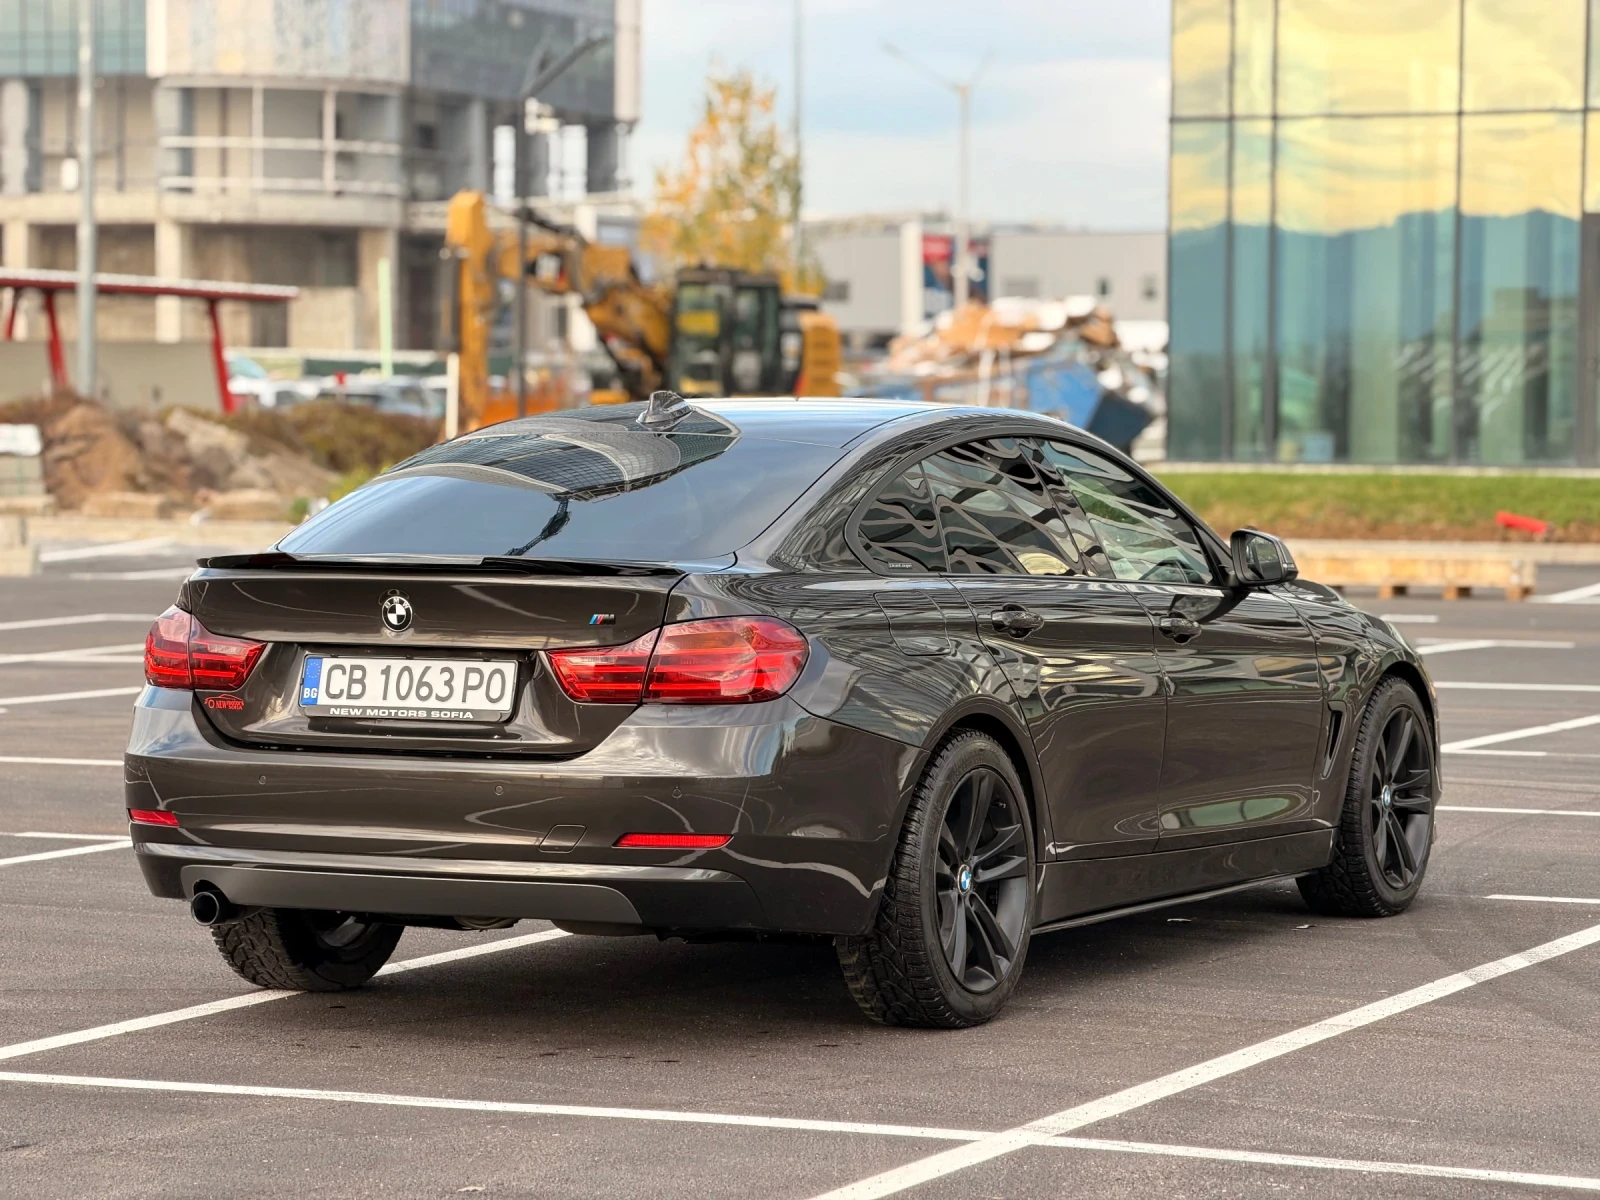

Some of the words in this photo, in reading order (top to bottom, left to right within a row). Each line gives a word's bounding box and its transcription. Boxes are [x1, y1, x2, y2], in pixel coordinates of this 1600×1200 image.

[325, 664, 367, 700] CB
[380, 665, 455, 702] 1063
[461, 667, 506, 704] PO
[303, 687, 318, 699] BG
[329, 707, 363, 716] NEW
[366, 709, 427, 718] MOTORS
[430, 710, 474, 719] SOFIA
